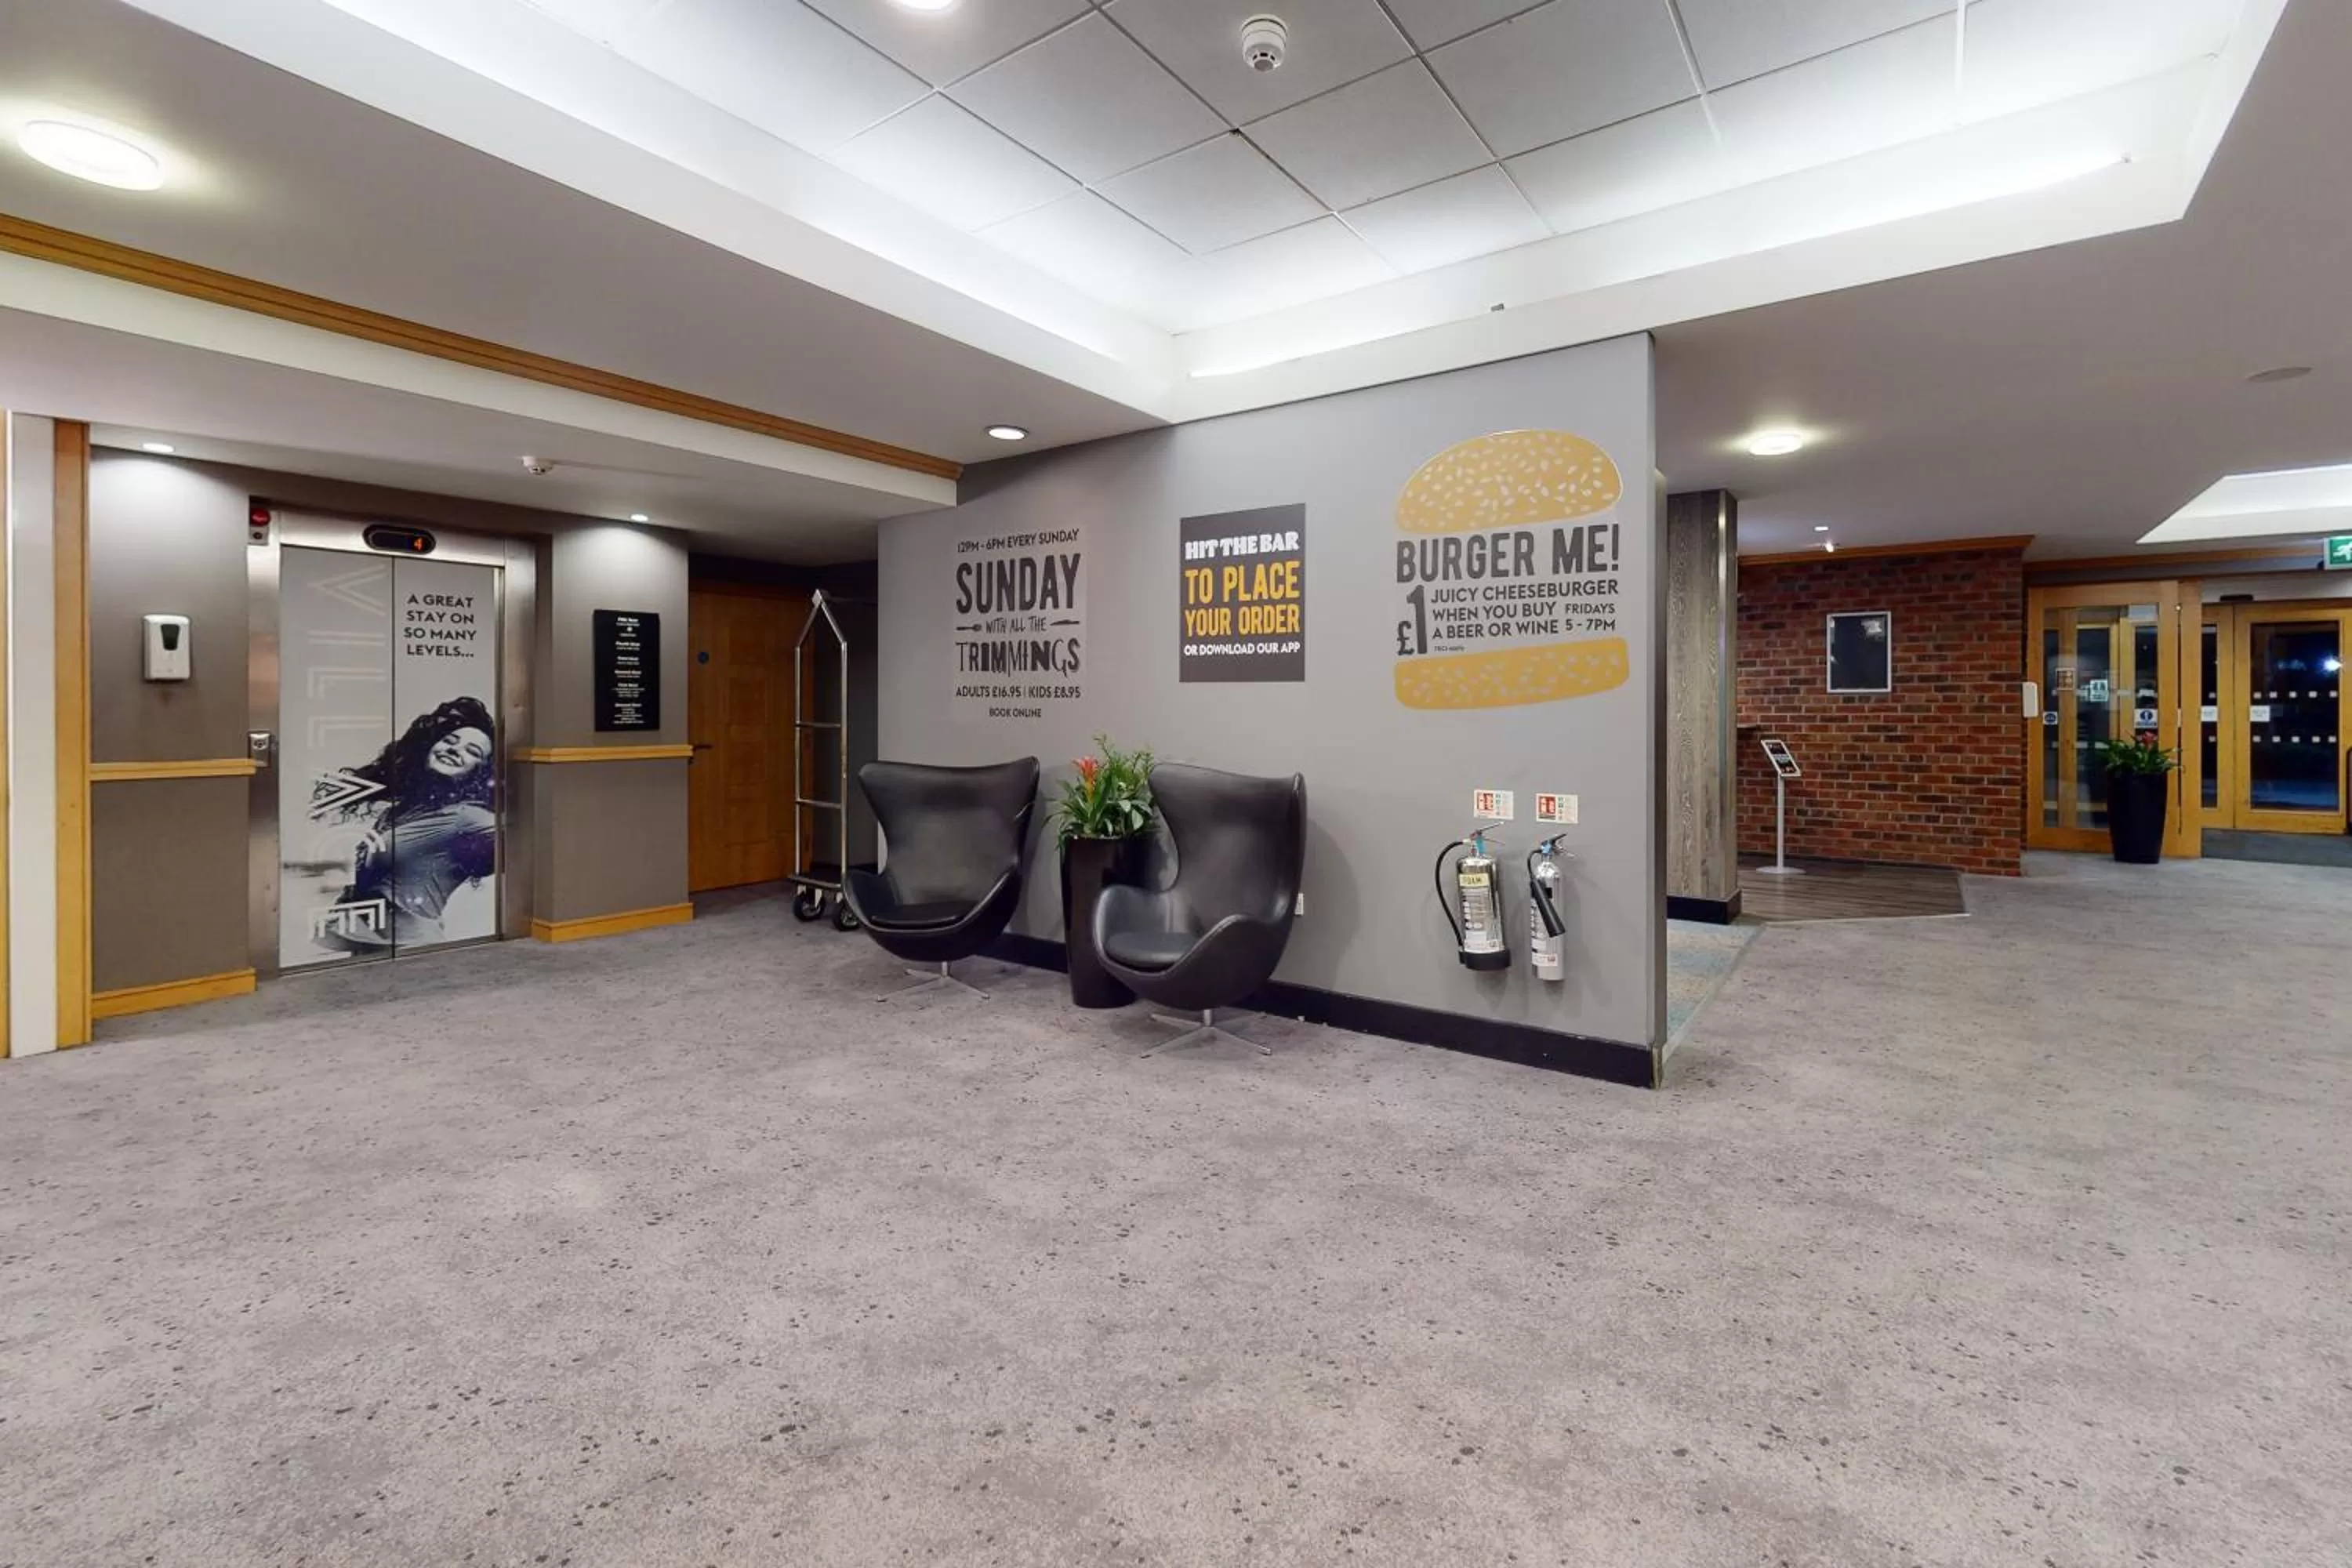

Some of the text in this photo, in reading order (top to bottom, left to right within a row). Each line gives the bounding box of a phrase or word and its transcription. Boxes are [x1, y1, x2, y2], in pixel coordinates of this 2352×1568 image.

[413, 537, 424, 550] 4
[957, 541, 979, 553] 12PM
[985, 538, 1006, 550] 6PM
[1007, 532, 1037, 548] EVERY
[1038, 528, 1080, 545] SUNDAY
[1185, 531, 1300, 560] HIT THE BAR
[1396, 523, 1620, 583] BURGER ME!
[956, 553, 1081, 614] SUNDAY
[1185, 561, 1301, 605] TO PLACE
[1431, 579, 1619, 604] JUICY CHEESEBURGER
[407, 594, 474, 608] A GREAT
[1565, 602, 1616, 615] FRIDAYS
[406, 610, 474, 624] STAY ON
[1185, 604, 1301, 637] YOUR ORDER
[1432, 601, 1557, 622] WHEN YOU BUY
[404, 626, 477, 641] SO MANY
[985, 615, 1047, 634] WITH ALL THE
[1432, 619, 1559, 640] A BEER OR WINE
[1565, 619, 1573, 632] 5
[1586, 618, 1616, 632] 7PM
[406, 644, 474, 658] LEVELS...
[955, 637, 1080, 678] TRIMMINGS
[1184, 641, 1301, 656] OR DOWNLOAD OUR APP
[956, 686, 990, 698] ADULTS
[992, 686, 1022, 698] £16.95
[1028, 686, 1052, 698] KIDS
[989, 708, 1042, 718] BOOK ONLINE
